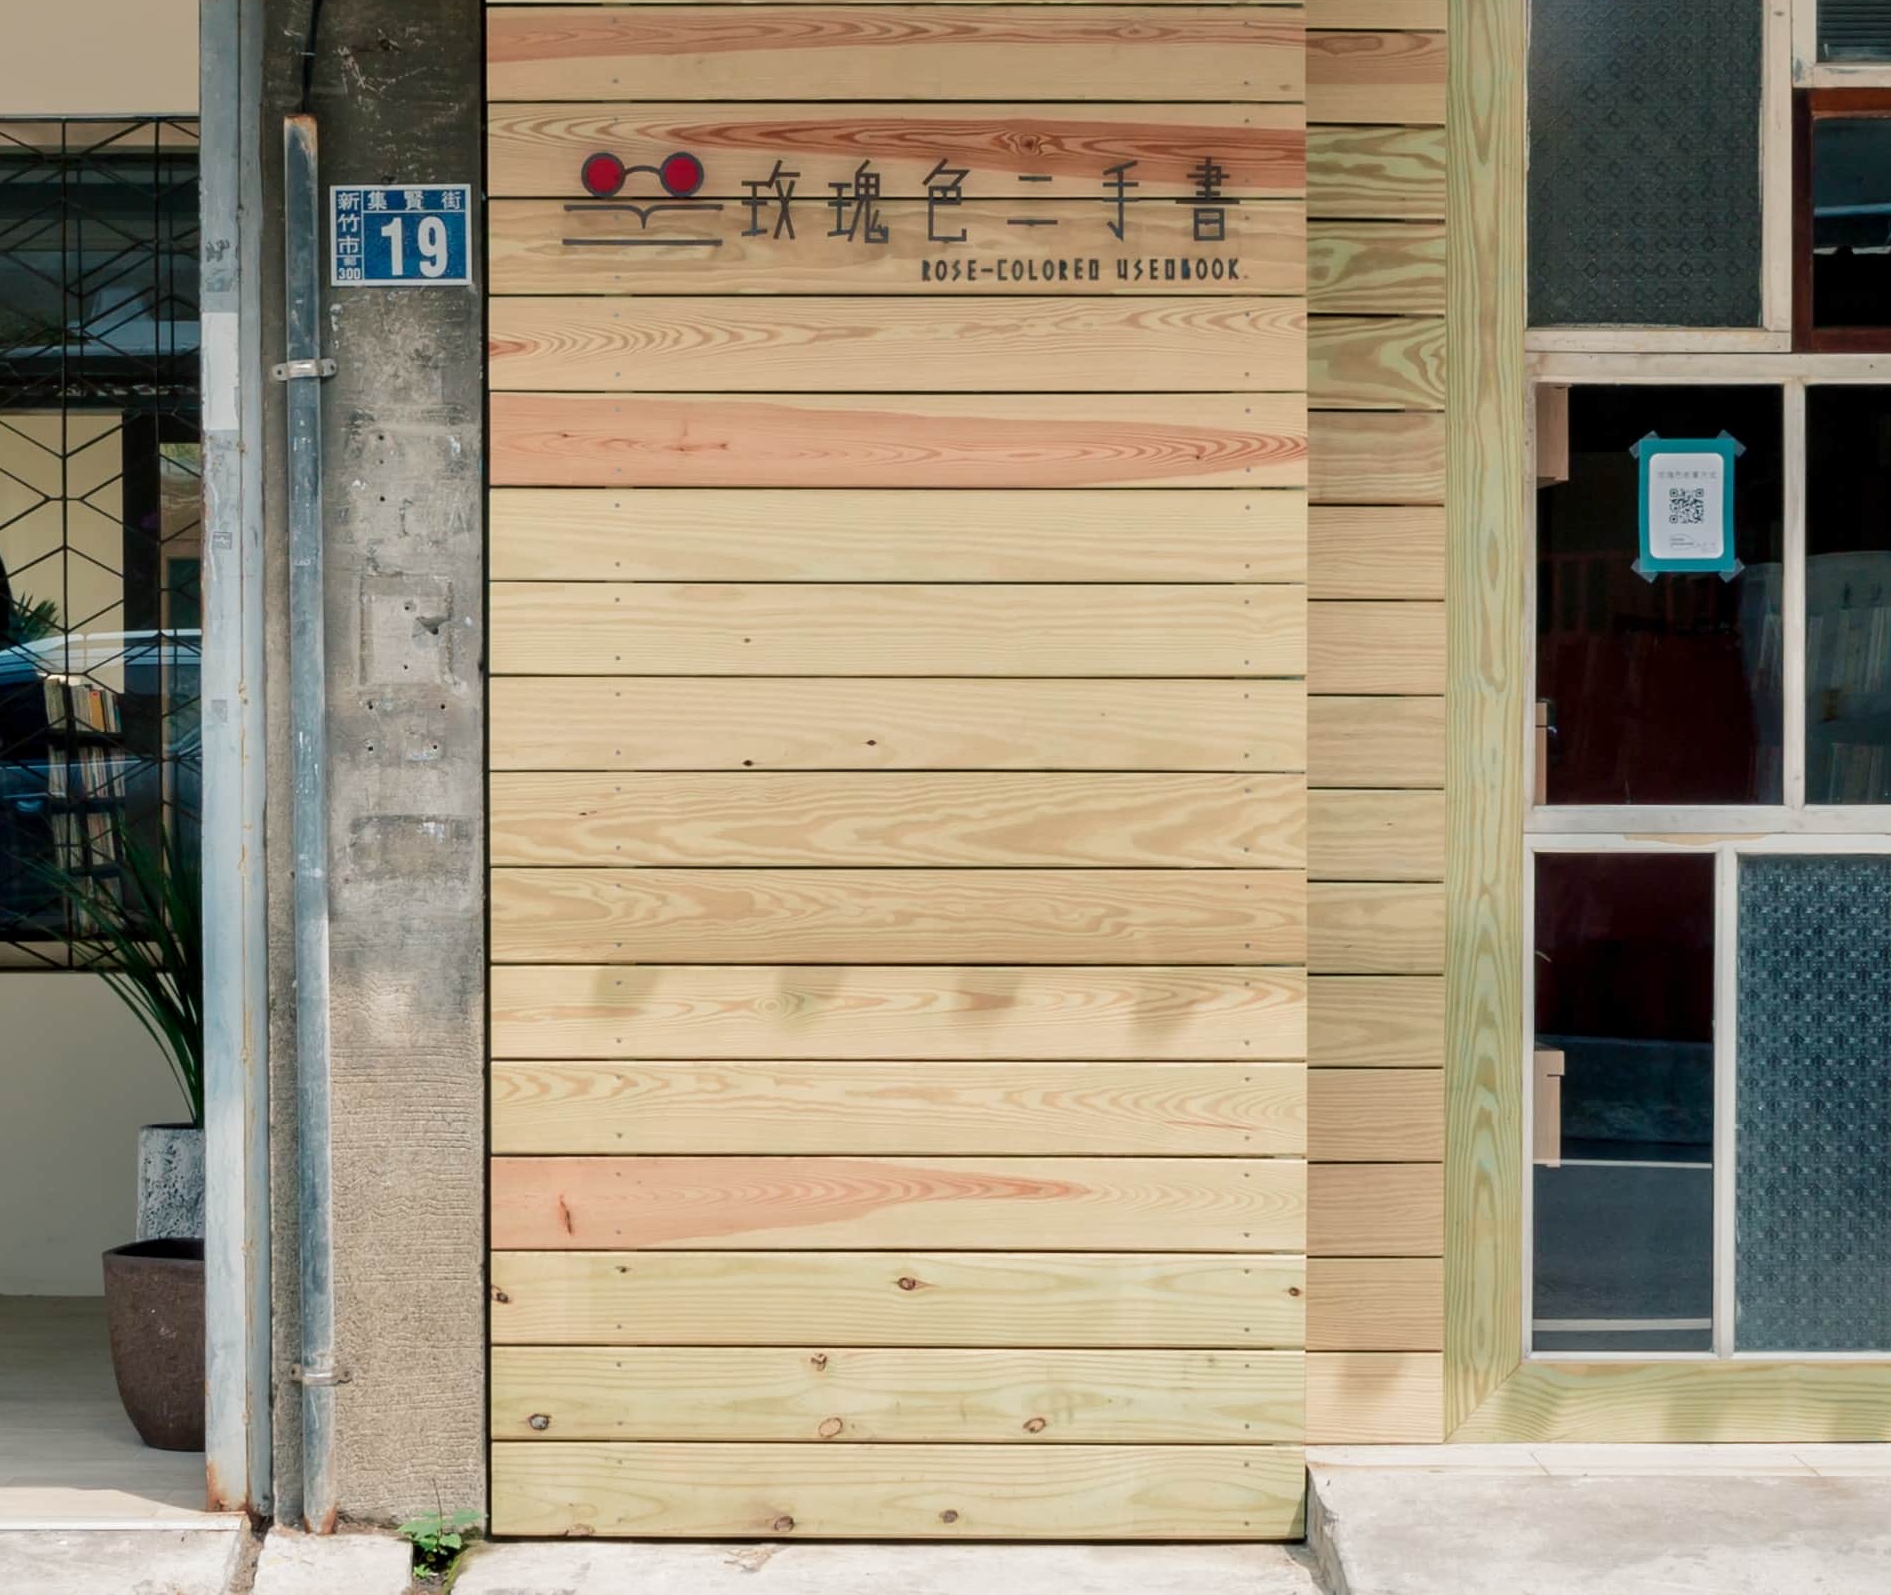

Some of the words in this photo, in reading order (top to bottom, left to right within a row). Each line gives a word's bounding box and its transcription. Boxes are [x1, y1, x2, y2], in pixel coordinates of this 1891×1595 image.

[367, 190, 462, 211] 集賢街
[740, 158, 1241, 244] 玫瑰色二手書
[336, 191, 361, 255] 新竹市
[381, 216, 449, 278] 19
[337, 267, 362, 281] 300
[920, 258, 1101, 282] ROSE-COLORED
